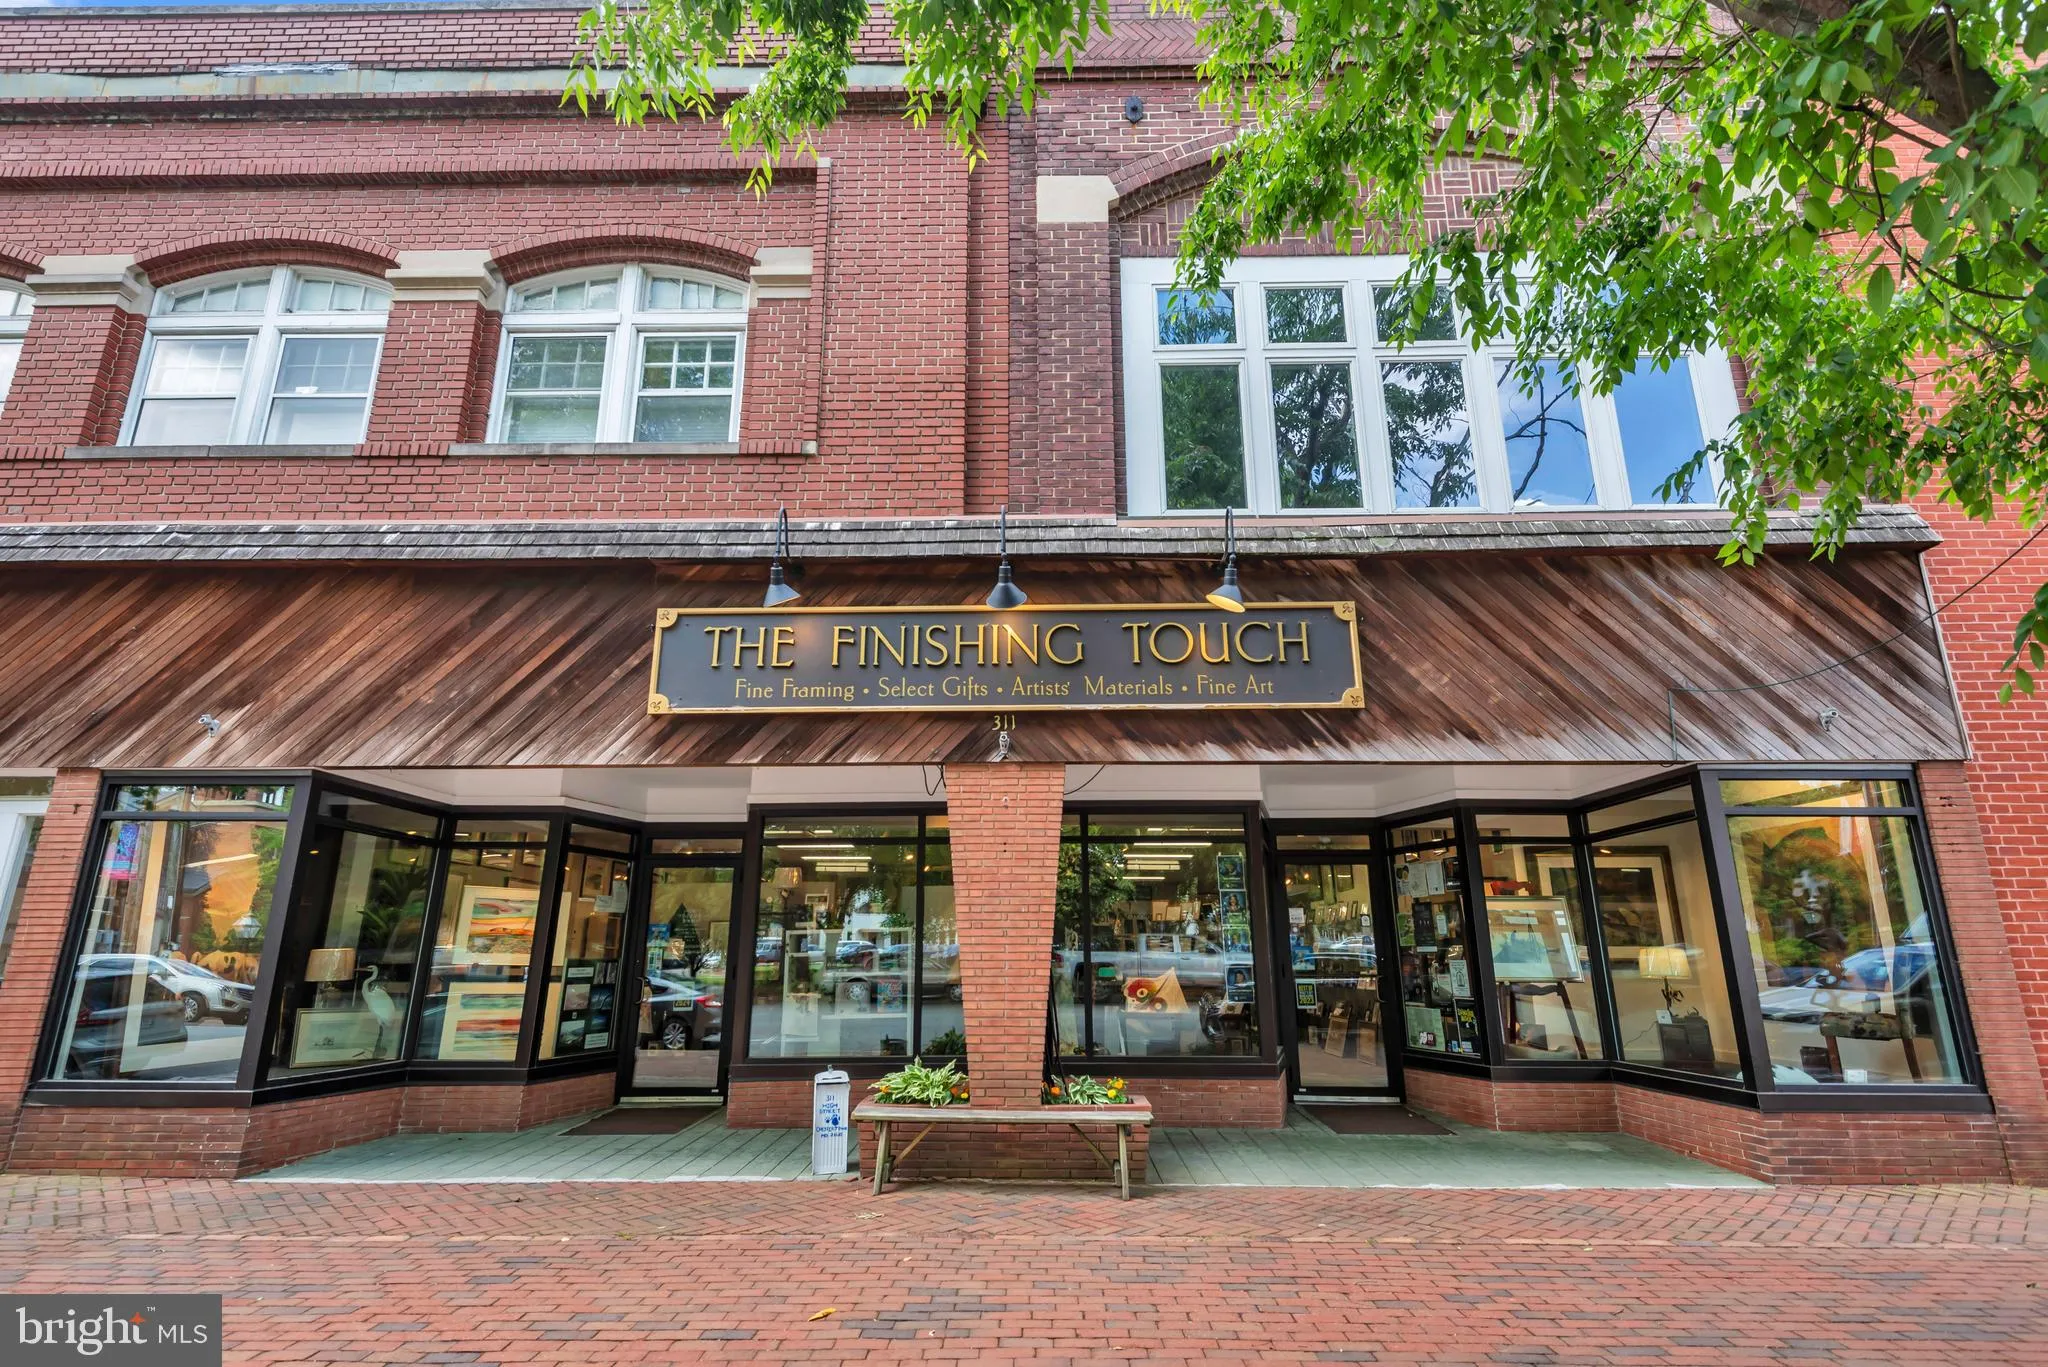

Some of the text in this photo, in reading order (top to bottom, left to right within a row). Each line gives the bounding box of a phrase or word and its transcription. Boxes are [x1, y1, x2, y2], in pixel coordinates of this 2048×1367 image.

[704, 621, 1311, 668] THE FINISHING TOUCH
[735, 678, 774, 699] Fine
[782, 678, 855, 701] Framing
[878, 677, 934, 698] Select
[942, 676, 988, 701] Gifts
[1084, 675, 1173, 696] Materials
[1197, 674, 1237, 695] Fine
[1245, 674, 1274, 695] Art
[992, 715, 1016, 730] 311
